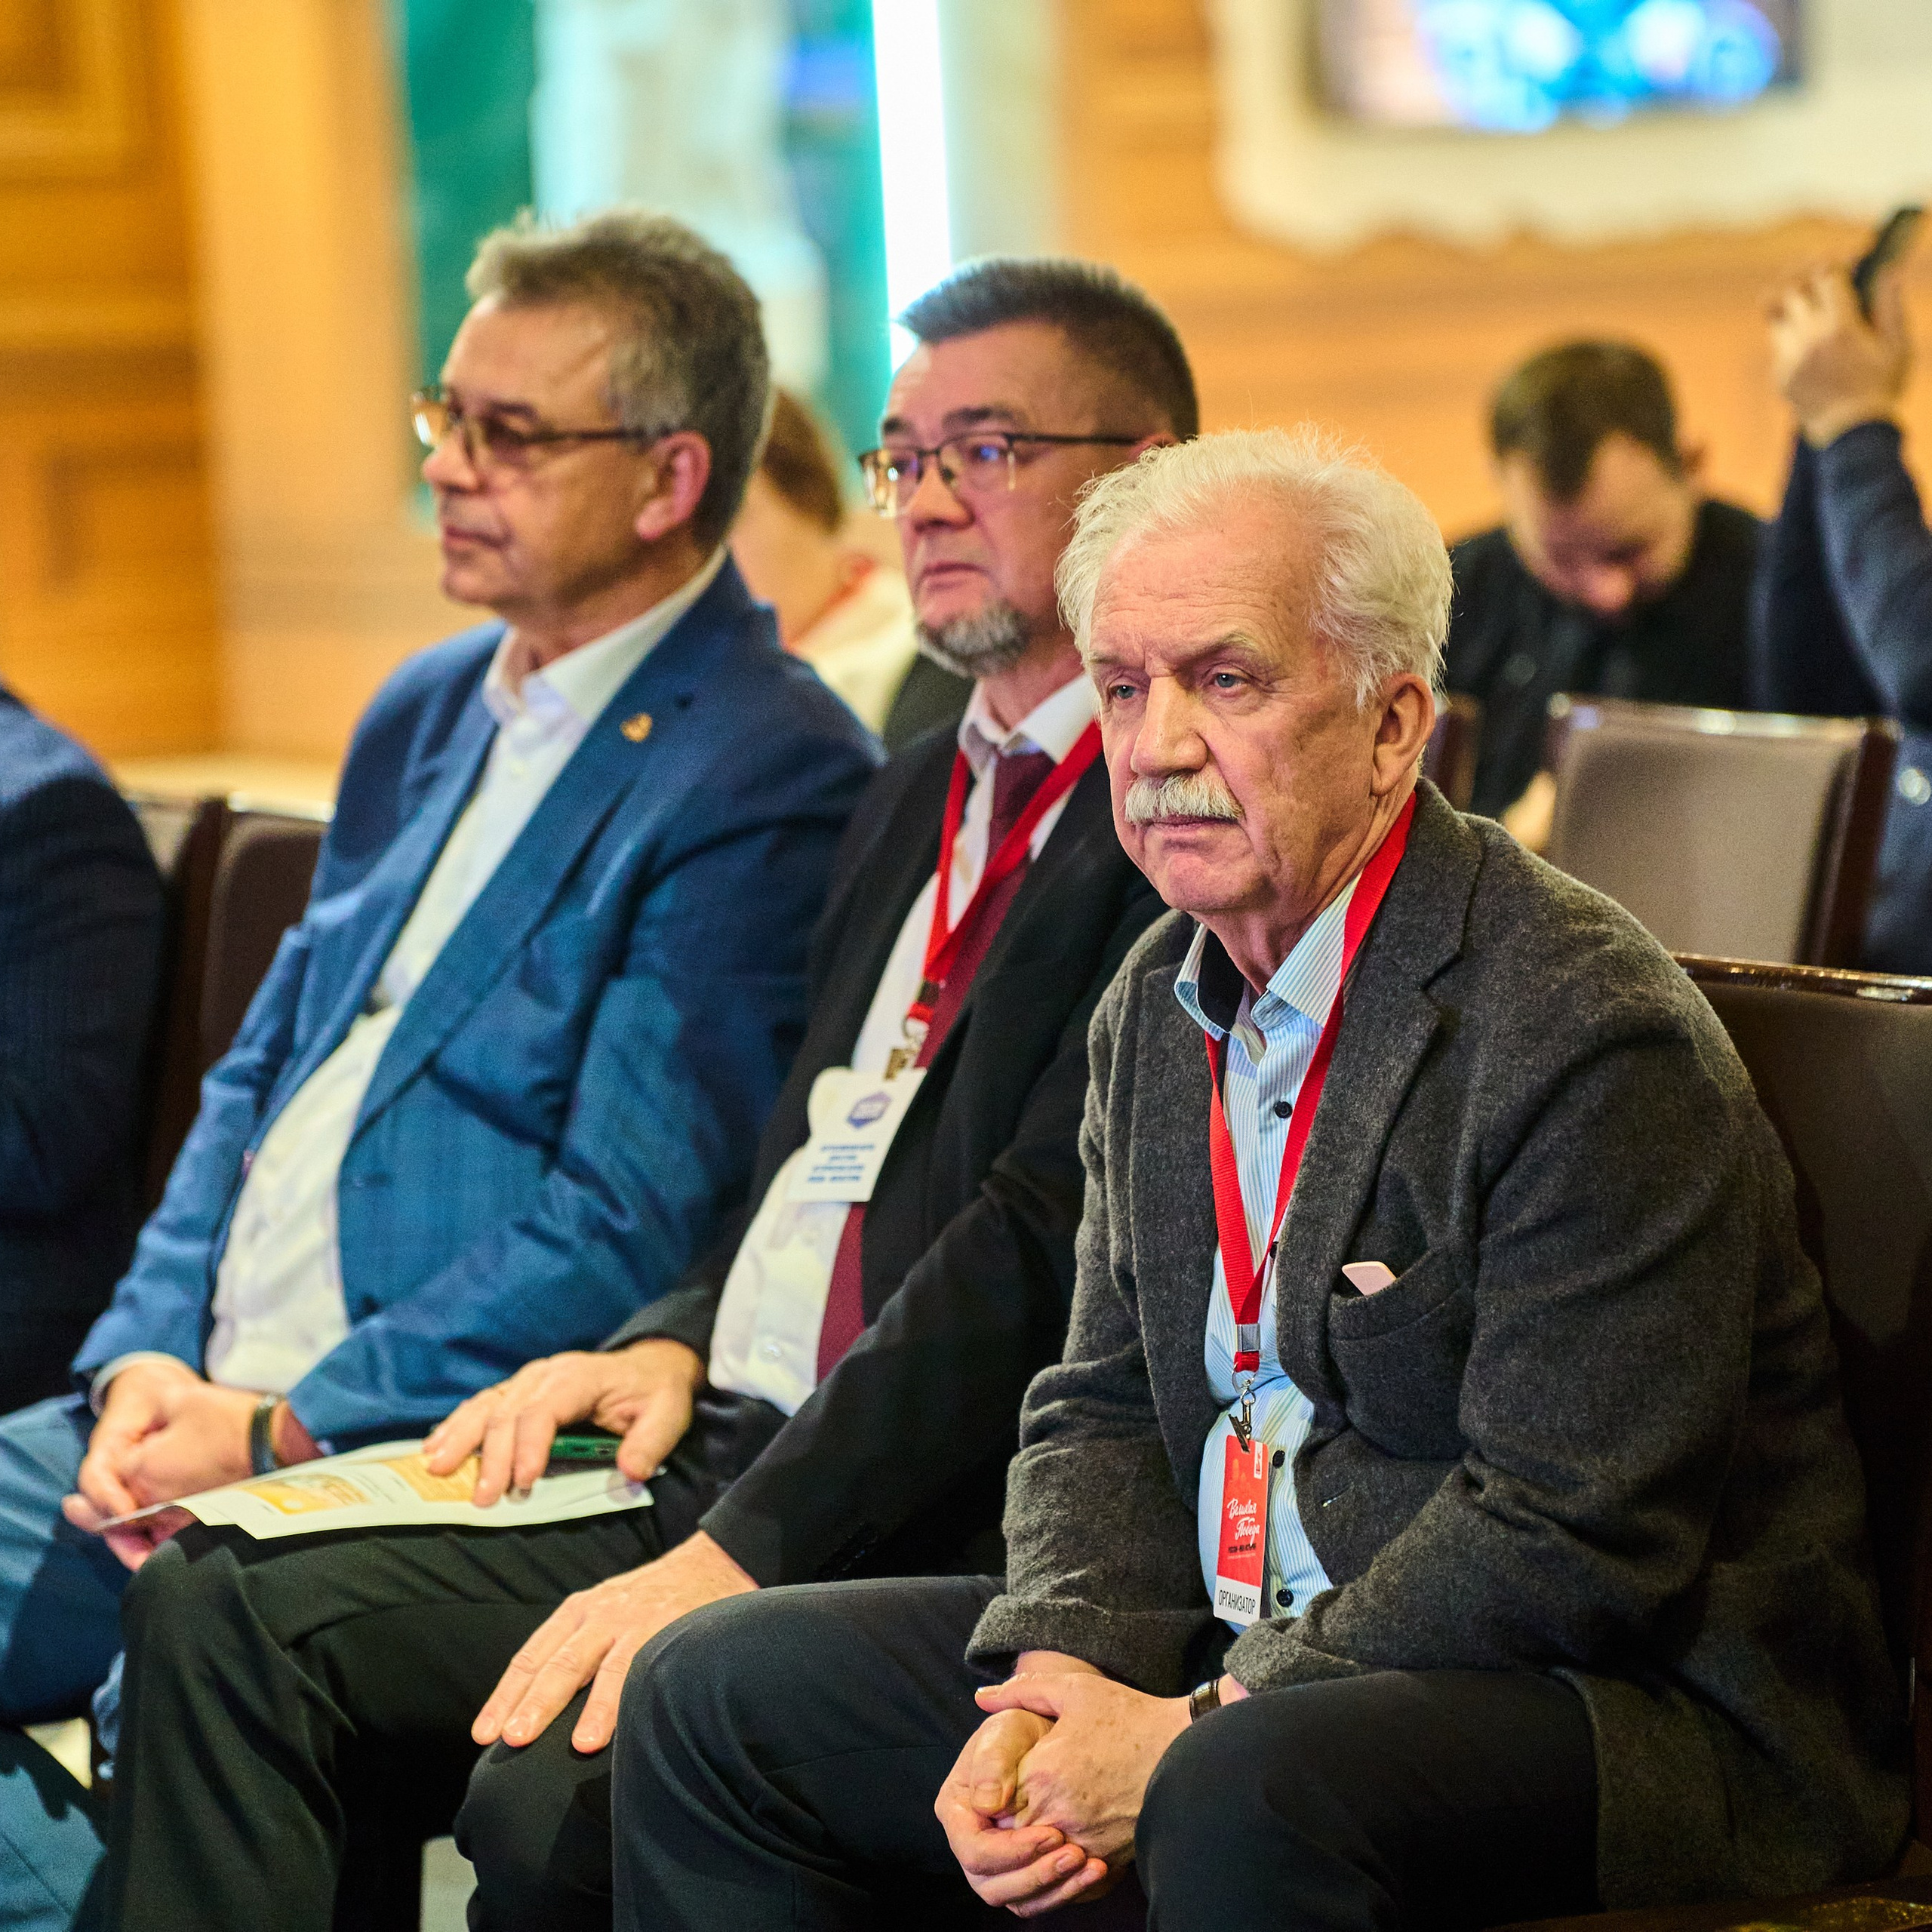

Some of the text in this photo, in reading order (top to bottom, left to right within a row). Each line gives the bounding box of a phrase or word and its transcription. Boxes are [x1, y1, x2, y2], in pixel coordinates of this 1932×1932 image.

[1227, 1498, 1257, 1520] Великая
[1235, 1516, 1261, 1547] Победа
[1219, 1589, 1257, 1614] ОРГАНИЗАТОР
